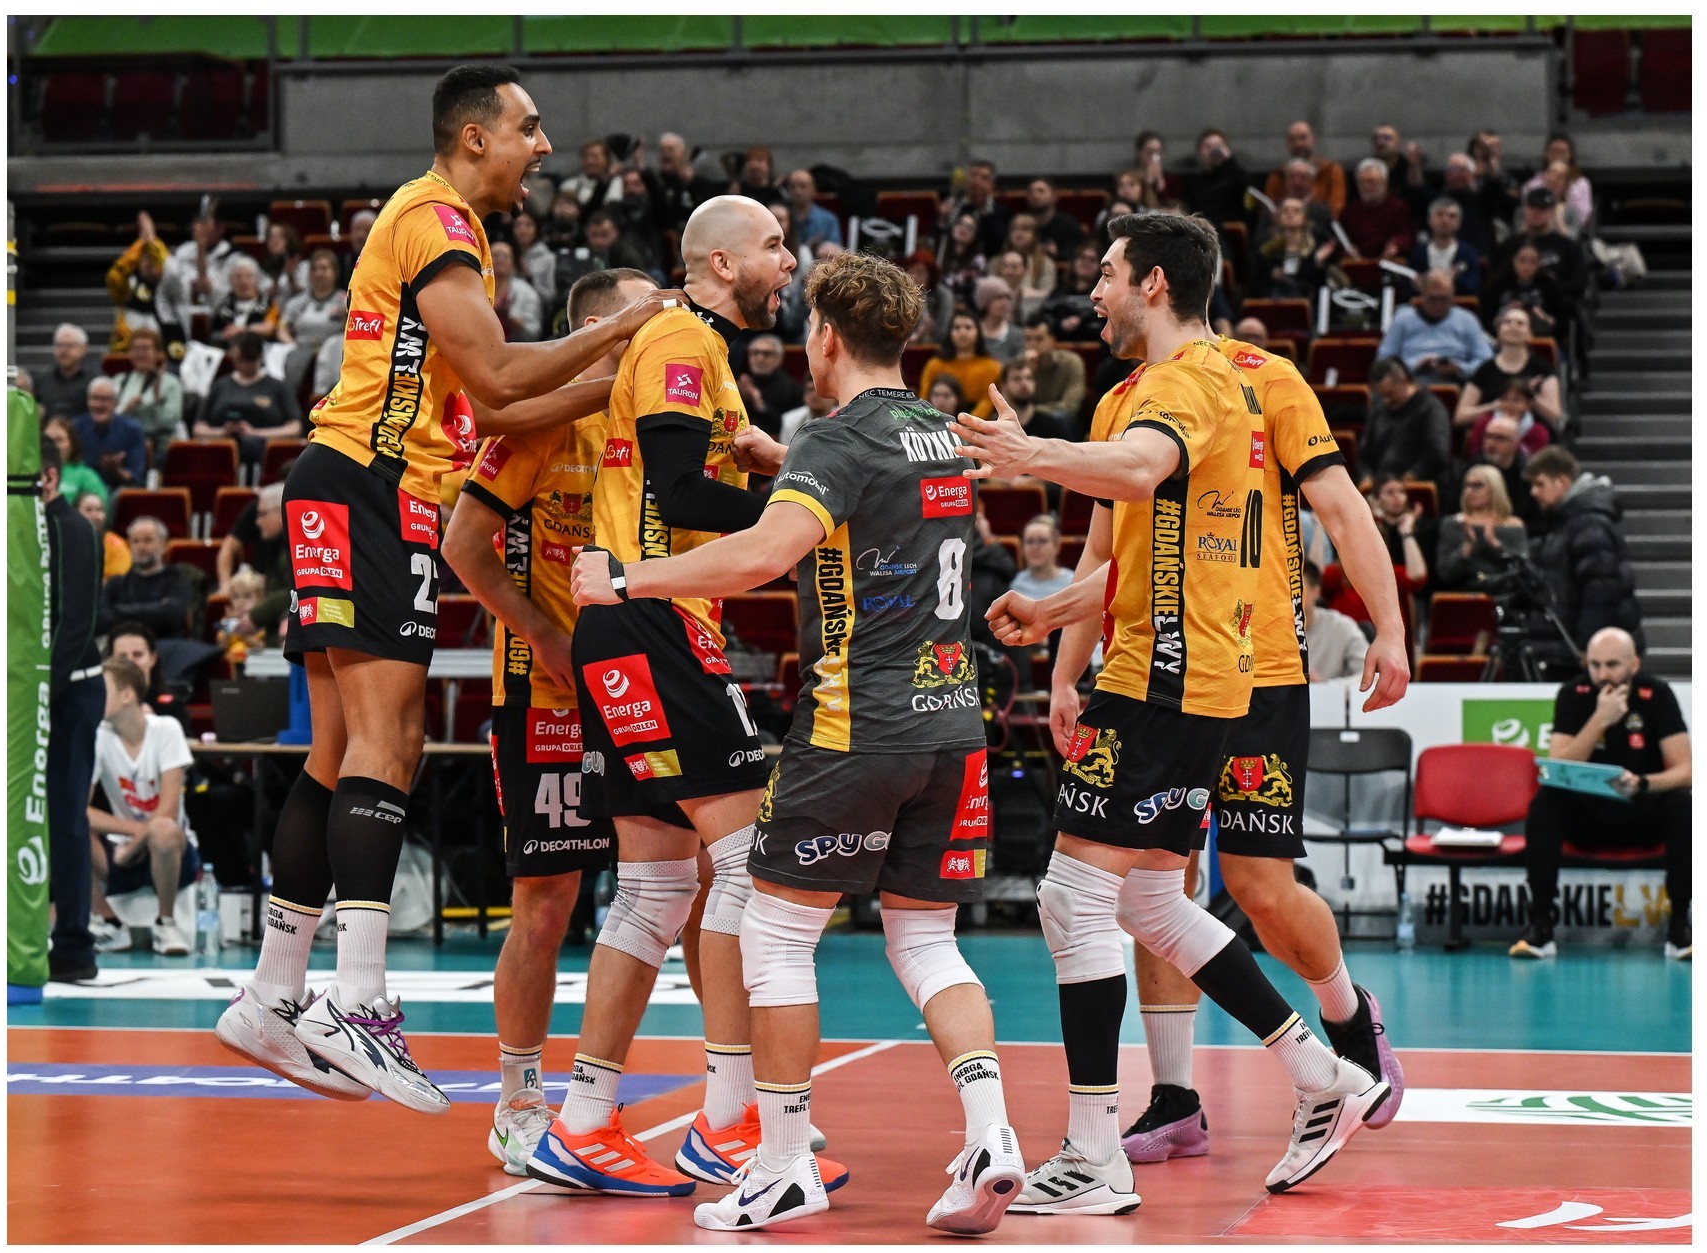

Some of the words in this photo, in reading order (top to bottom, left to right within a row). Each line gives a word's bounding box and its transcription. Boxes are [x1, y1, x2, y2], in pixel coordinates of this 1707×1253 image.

[668, 388, 699, 400] TAURON
[939, 485, 968, 499] Energa
[544, 519, 594, 539] GDAŃS
[1240, 489, 1264, 569] 10
[295, 544, 340, 563] Energa
[296, 567, 320, 576] GRUPA
[935, 538, 967, 620] 8
[912, 685, 980, 712] GDAŃS
[603, 699, 652, 720] Energa
[631, 720, 658, 732] ORLEN
[535, 743, 561, 752] GRUPA
[563, 743, 583, 751] ORLE
[534, 772, 592, 829] 49
[540, 837, 610, 853] DECATHLON
